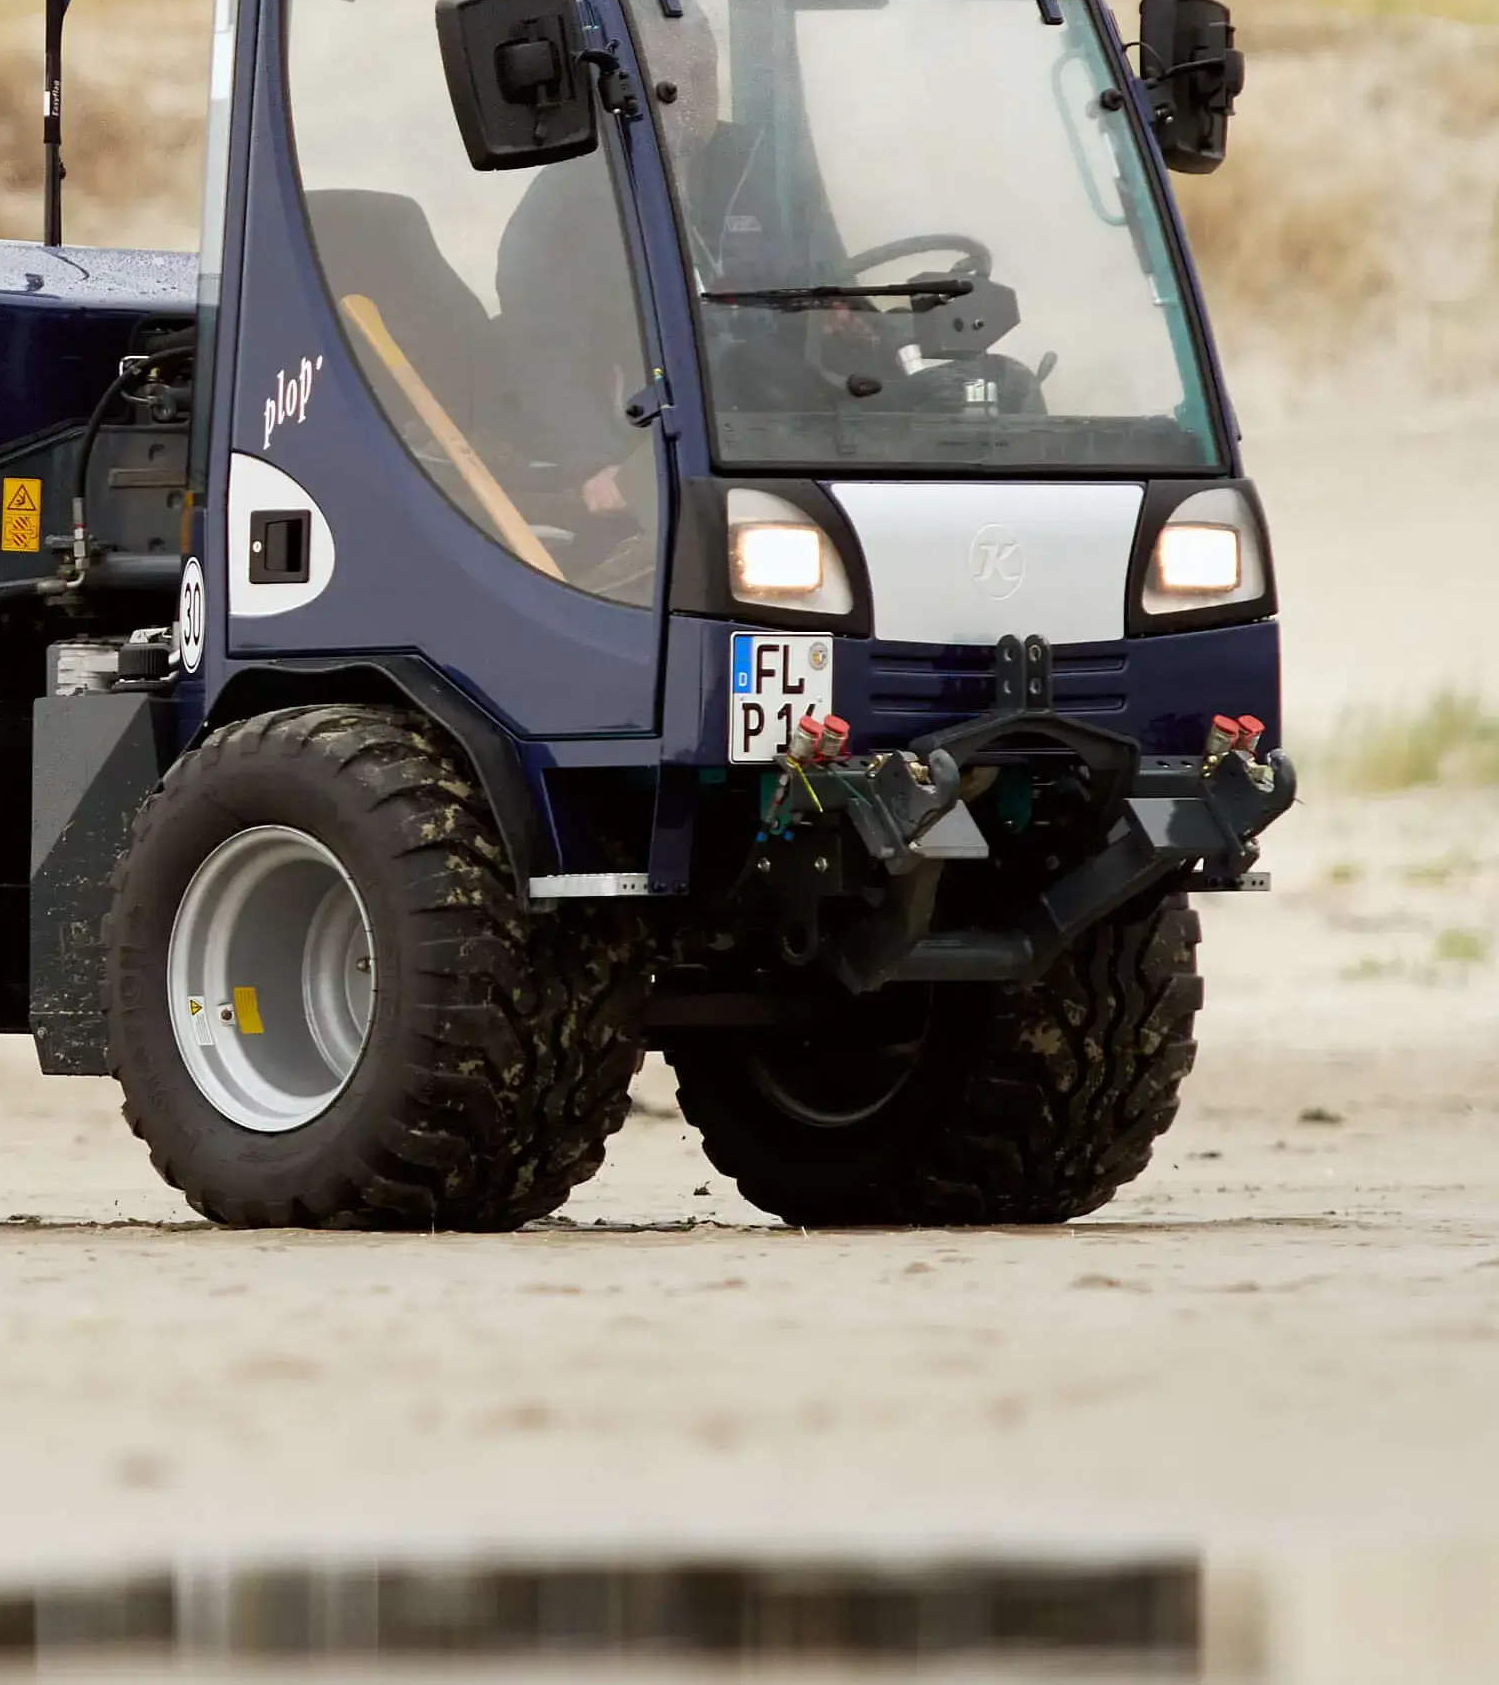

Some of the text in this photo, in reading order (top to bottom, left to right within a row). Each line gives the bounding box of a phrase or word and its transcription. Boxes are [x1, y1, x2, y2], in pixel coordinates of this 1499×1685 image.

[184, 582, 201, 646] 30
[738, 671, 748, 687] D
[755, 644, 805, 694] FL
